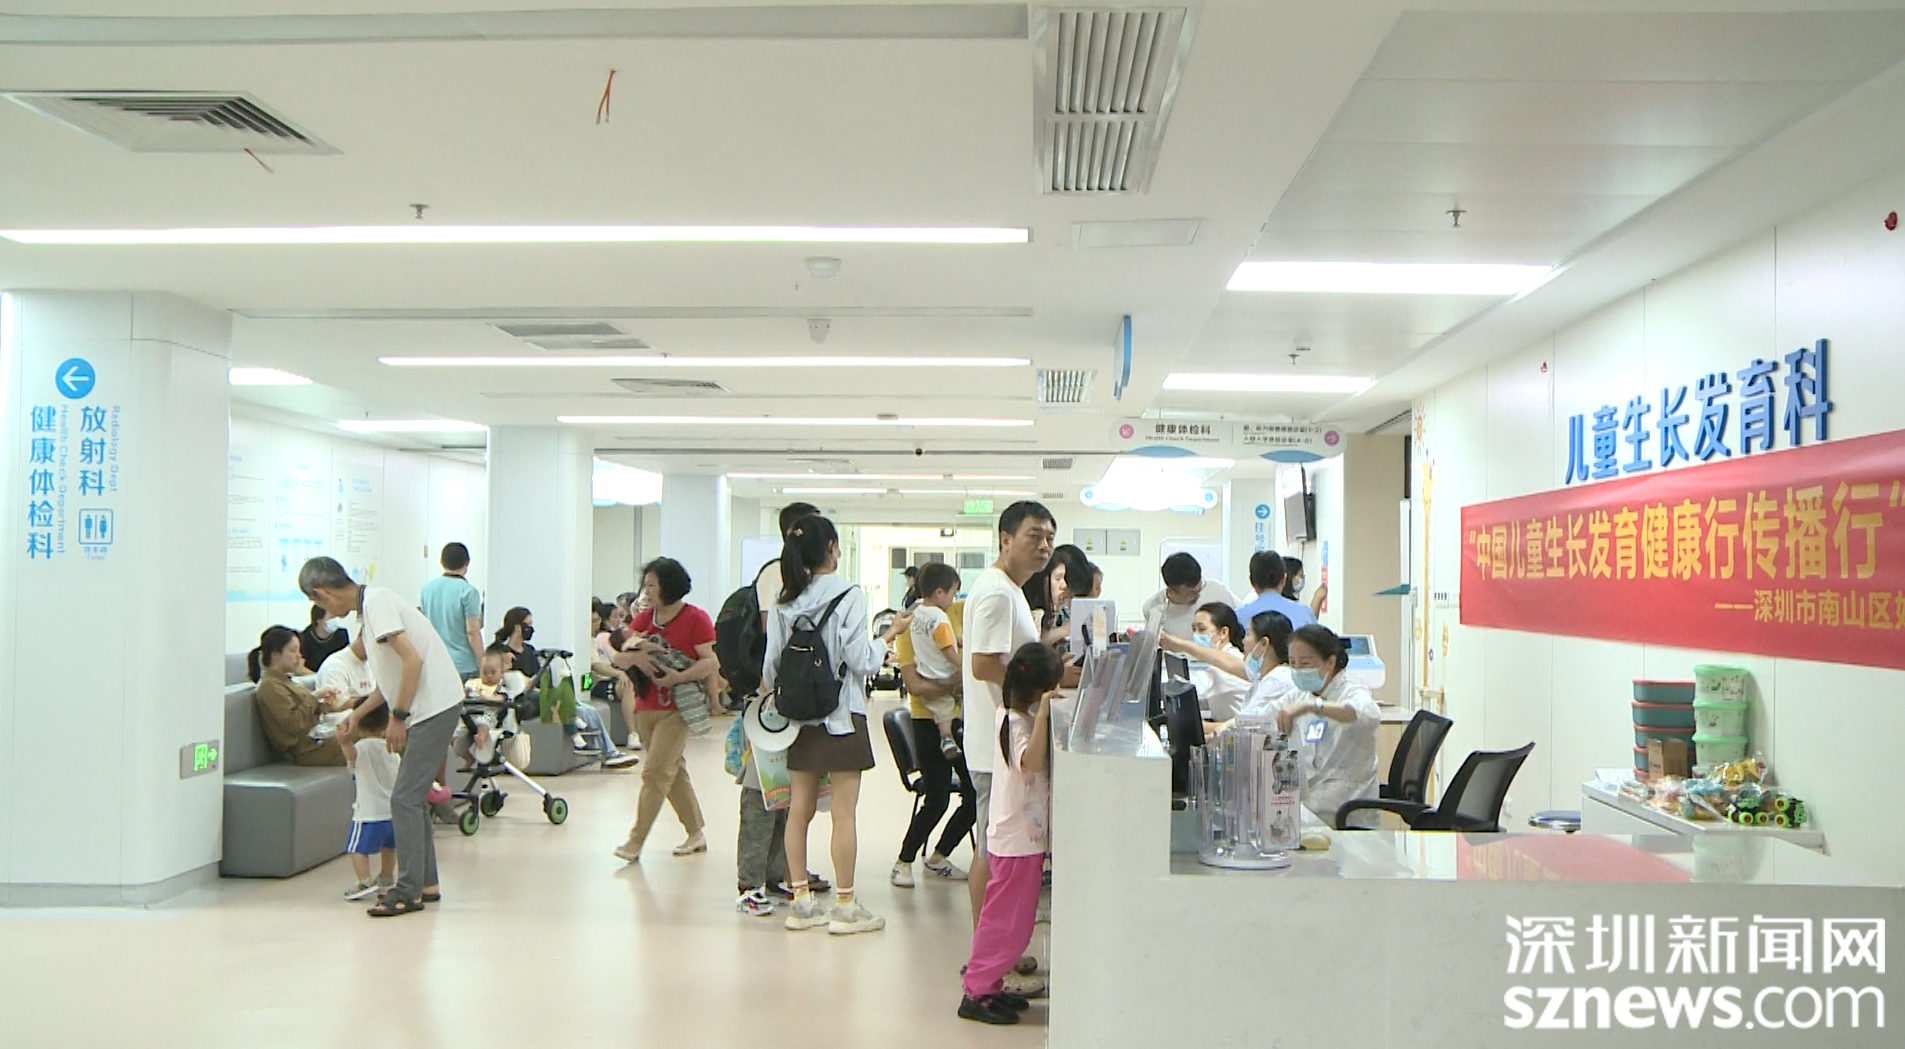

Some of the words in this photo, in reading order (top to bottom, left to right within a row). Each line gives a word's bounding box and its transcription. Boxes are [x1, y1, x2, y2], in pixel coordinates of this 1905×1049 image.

[79, 406, 107, 497] 放射科
[1155, 423, 1211, 435] 健康体检科
[1565, 338, 1834, 485] 儿童生长发育科
[27, 405, 56, 559] 健康体检科
